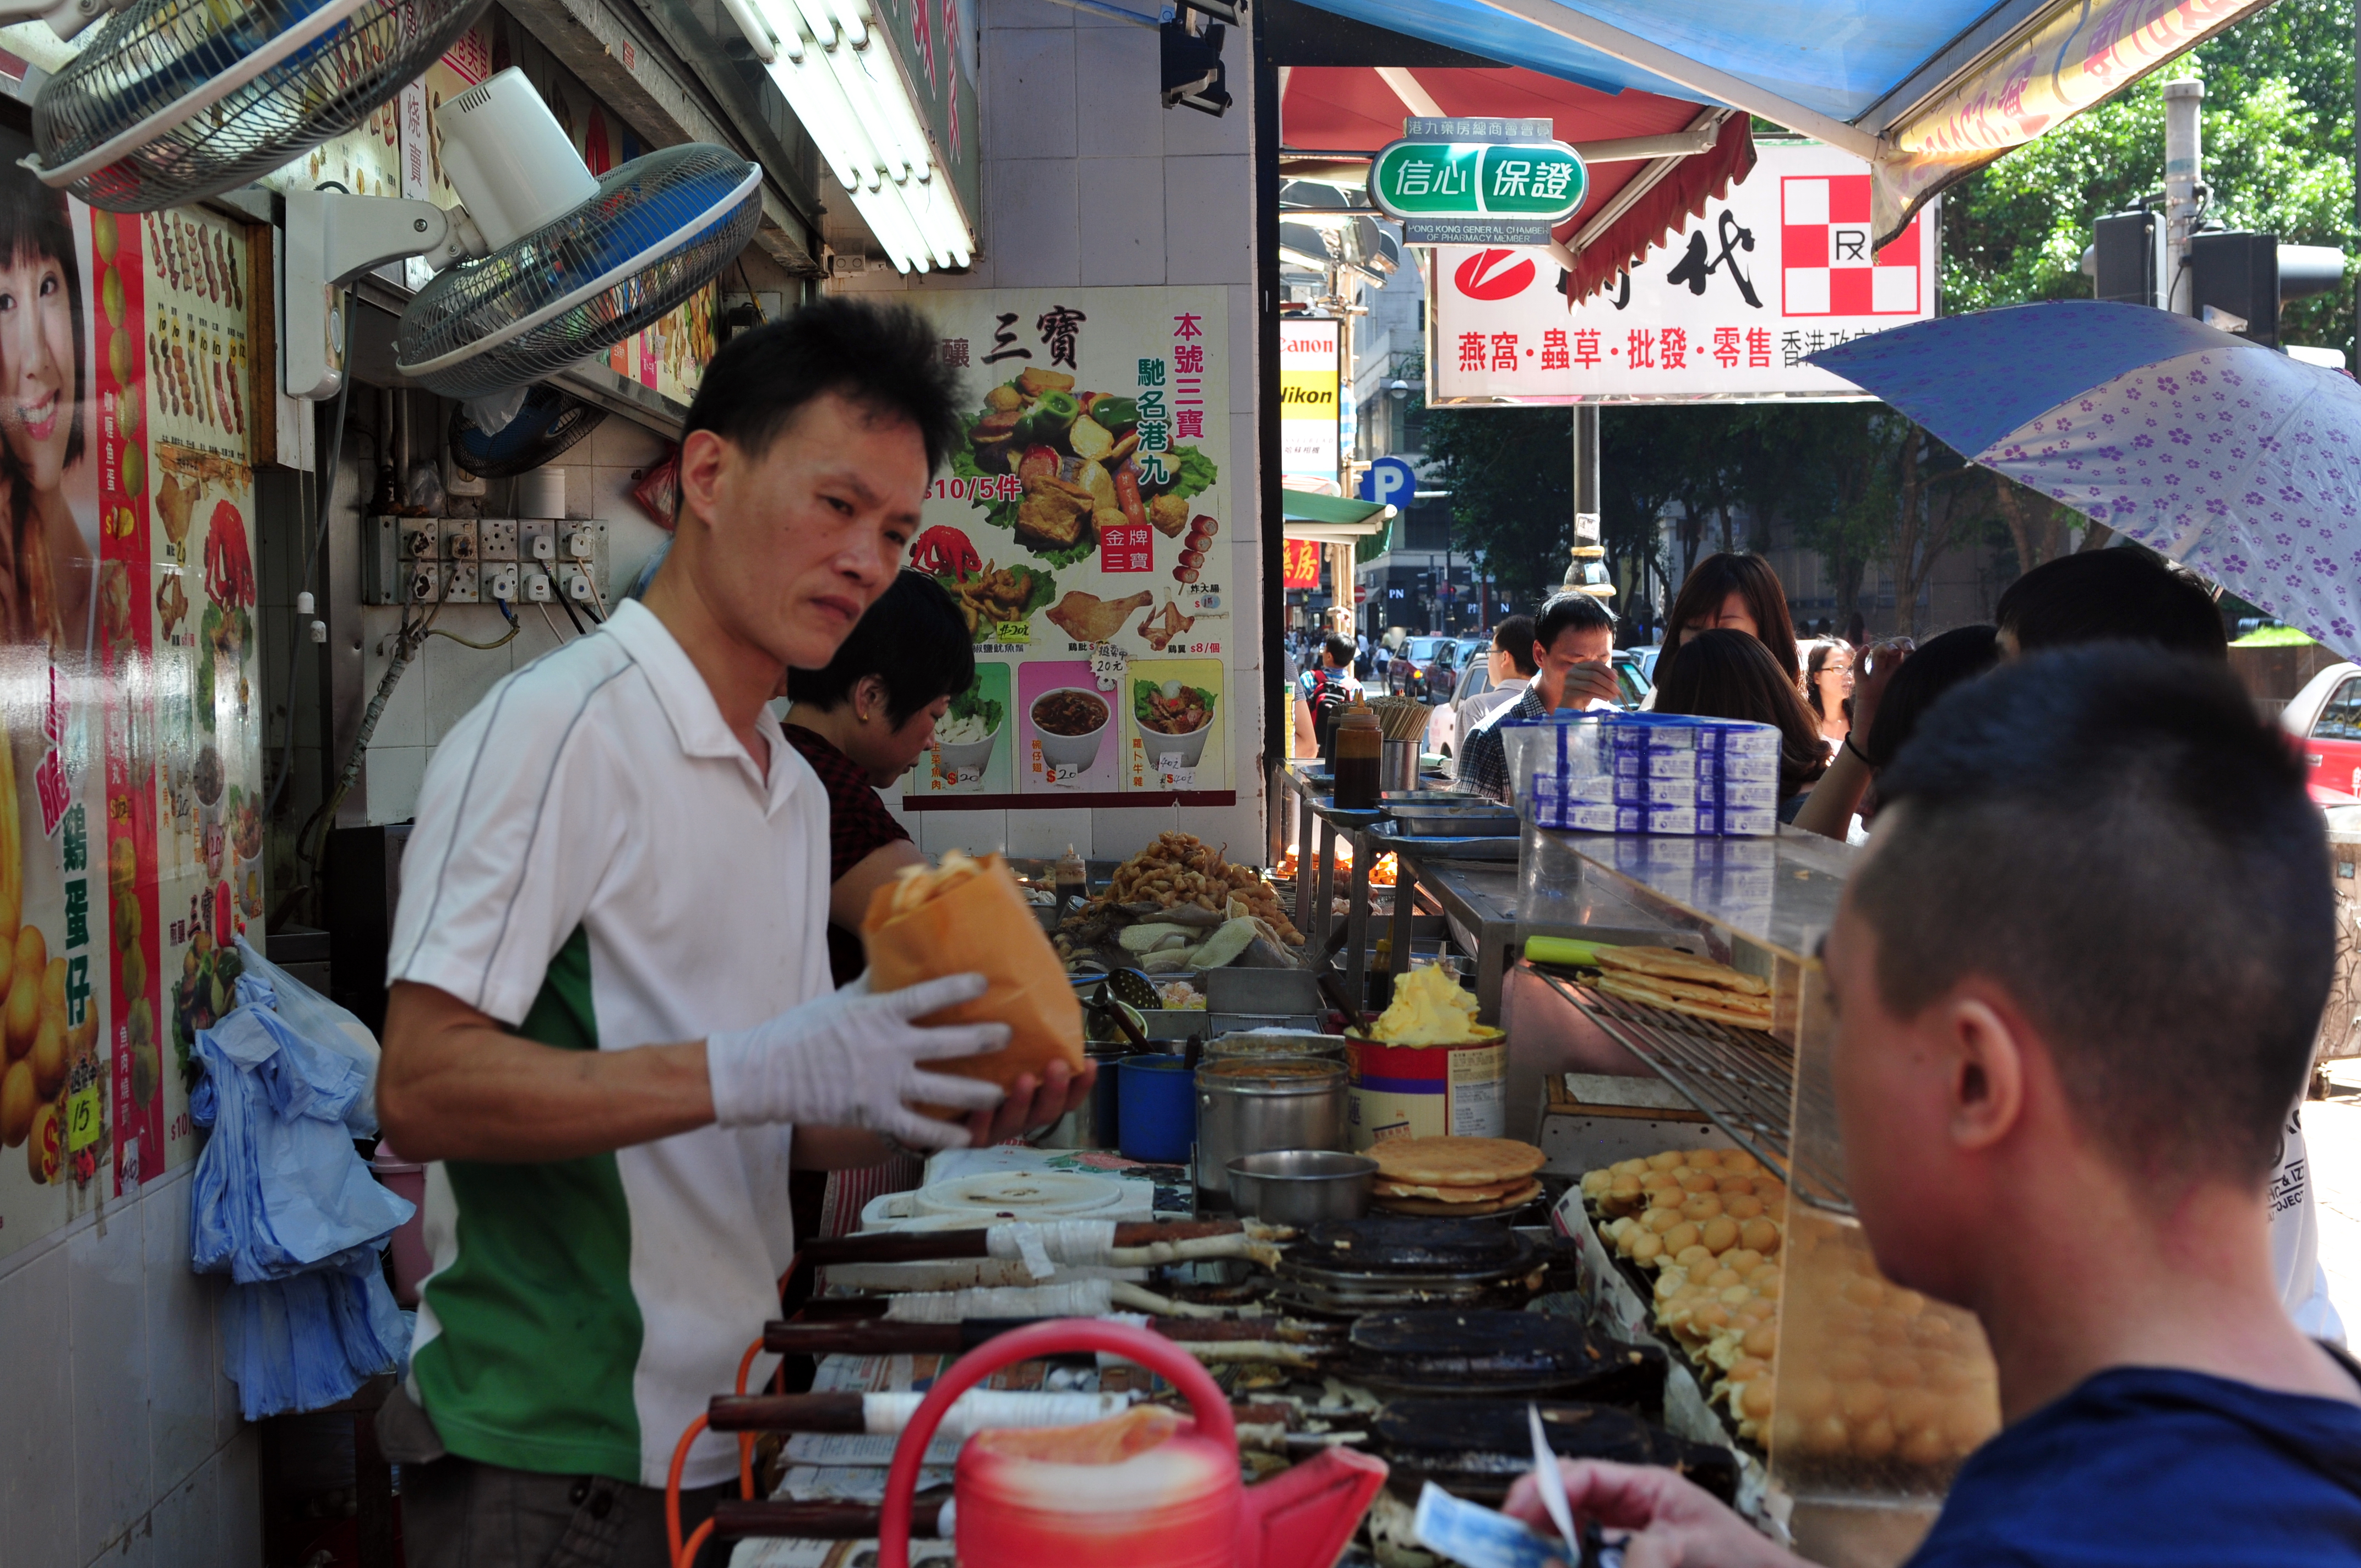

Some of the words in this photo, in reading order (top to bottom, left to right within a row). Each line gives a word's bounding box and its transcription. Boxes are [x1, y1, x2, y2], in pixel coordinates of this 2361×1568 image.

[1395, 158, 1467, 196] 信心
[1493, 160, 1574, 201] 保證
[1408, 225, 1434, 233] HONG
[1435, 225, 1461, 233] KONG
[1462, 226, 1504, 234] GENERAL
[1506, 226, 1549, 235] CHAMBER
[1427, 233, 1439, 242] OF
[1441, 233, 1492, 242] PHARMACY
[1494, 235, 1531, 243] MEMBER
[1173, 312, 1204, 439] 本號三寶
[1136, 358, 1171, 484] 馳名港九
[1374, 466, 1404, 504] P
[1106, 529, 1149, 547] 金牌
[1106, 552, 1149, 570] 三寶
[1096, 660, 1123, 672] 20元
